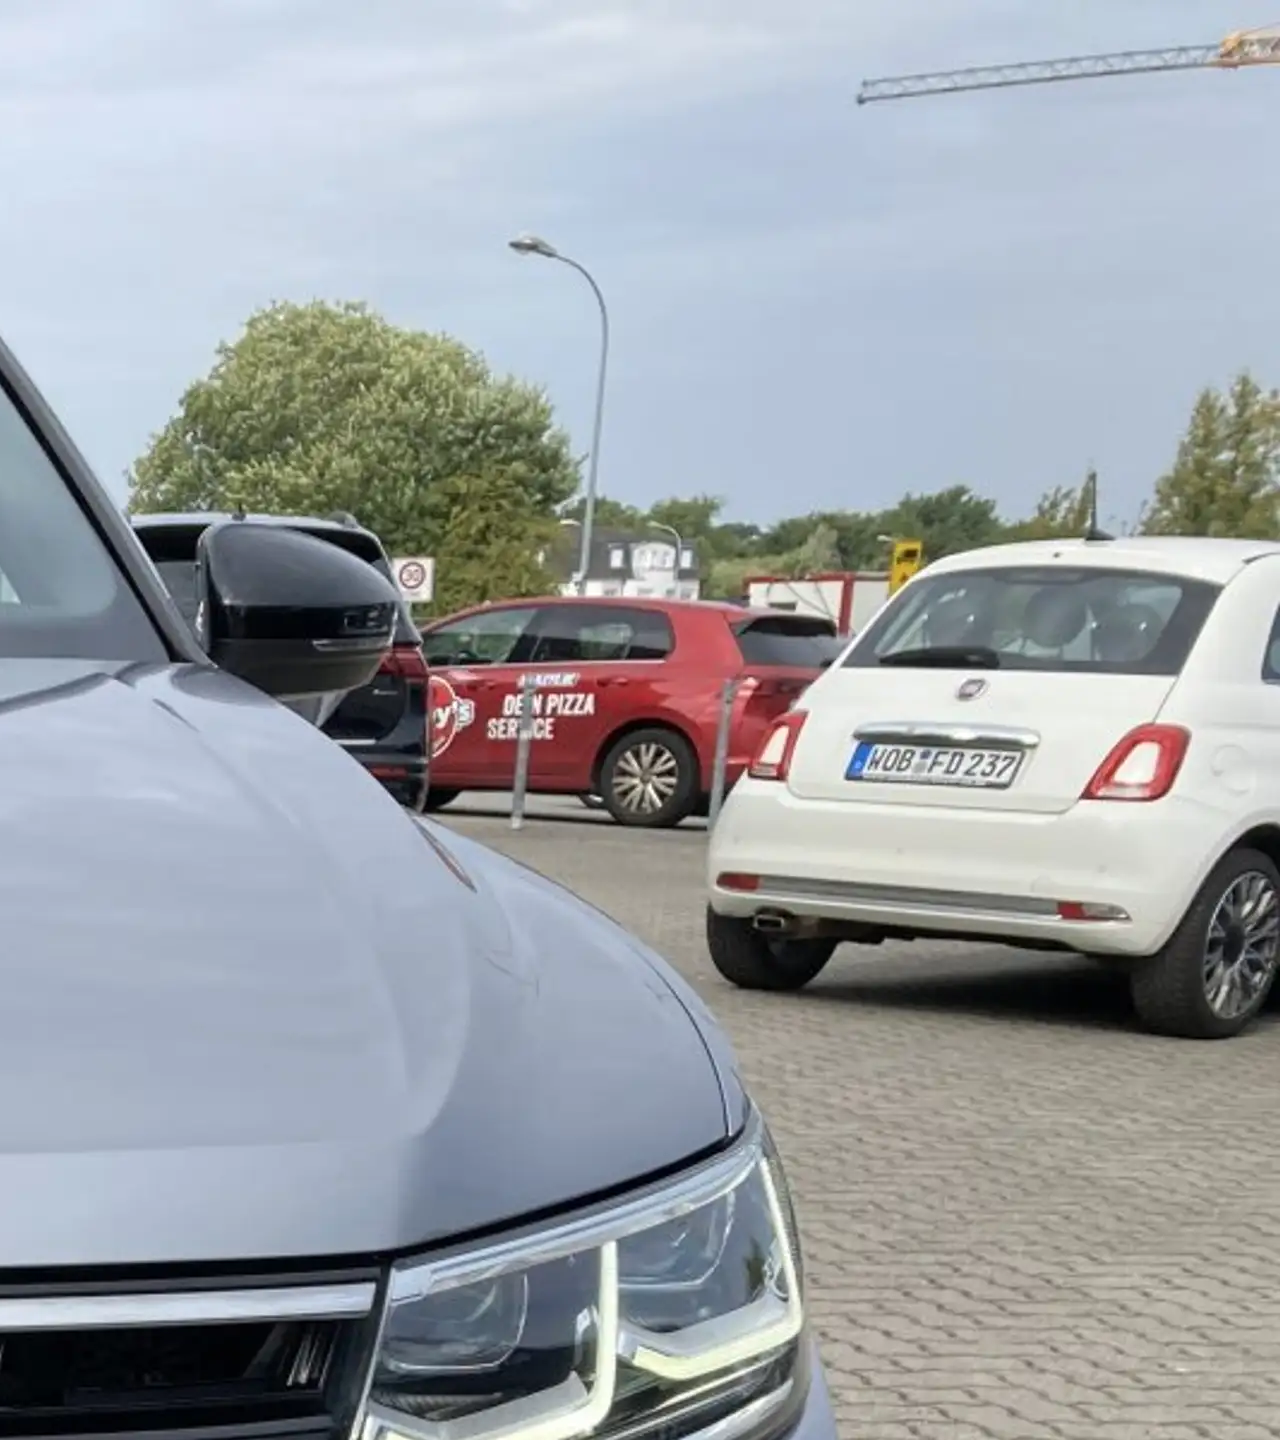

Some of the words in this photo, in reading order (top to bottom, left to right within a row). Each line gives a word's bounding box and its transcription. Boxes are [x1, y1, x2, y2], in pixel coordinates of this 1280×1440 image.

[503, 693, 542, 716] DEN
[546, 692, 595, 716] PIZZA
[488, 718, 555, 740] SERCE
[867, 748, 915, 774] WOB
[927, 751, 964, 775] FD
[964, 754, 1016, 779] 237
